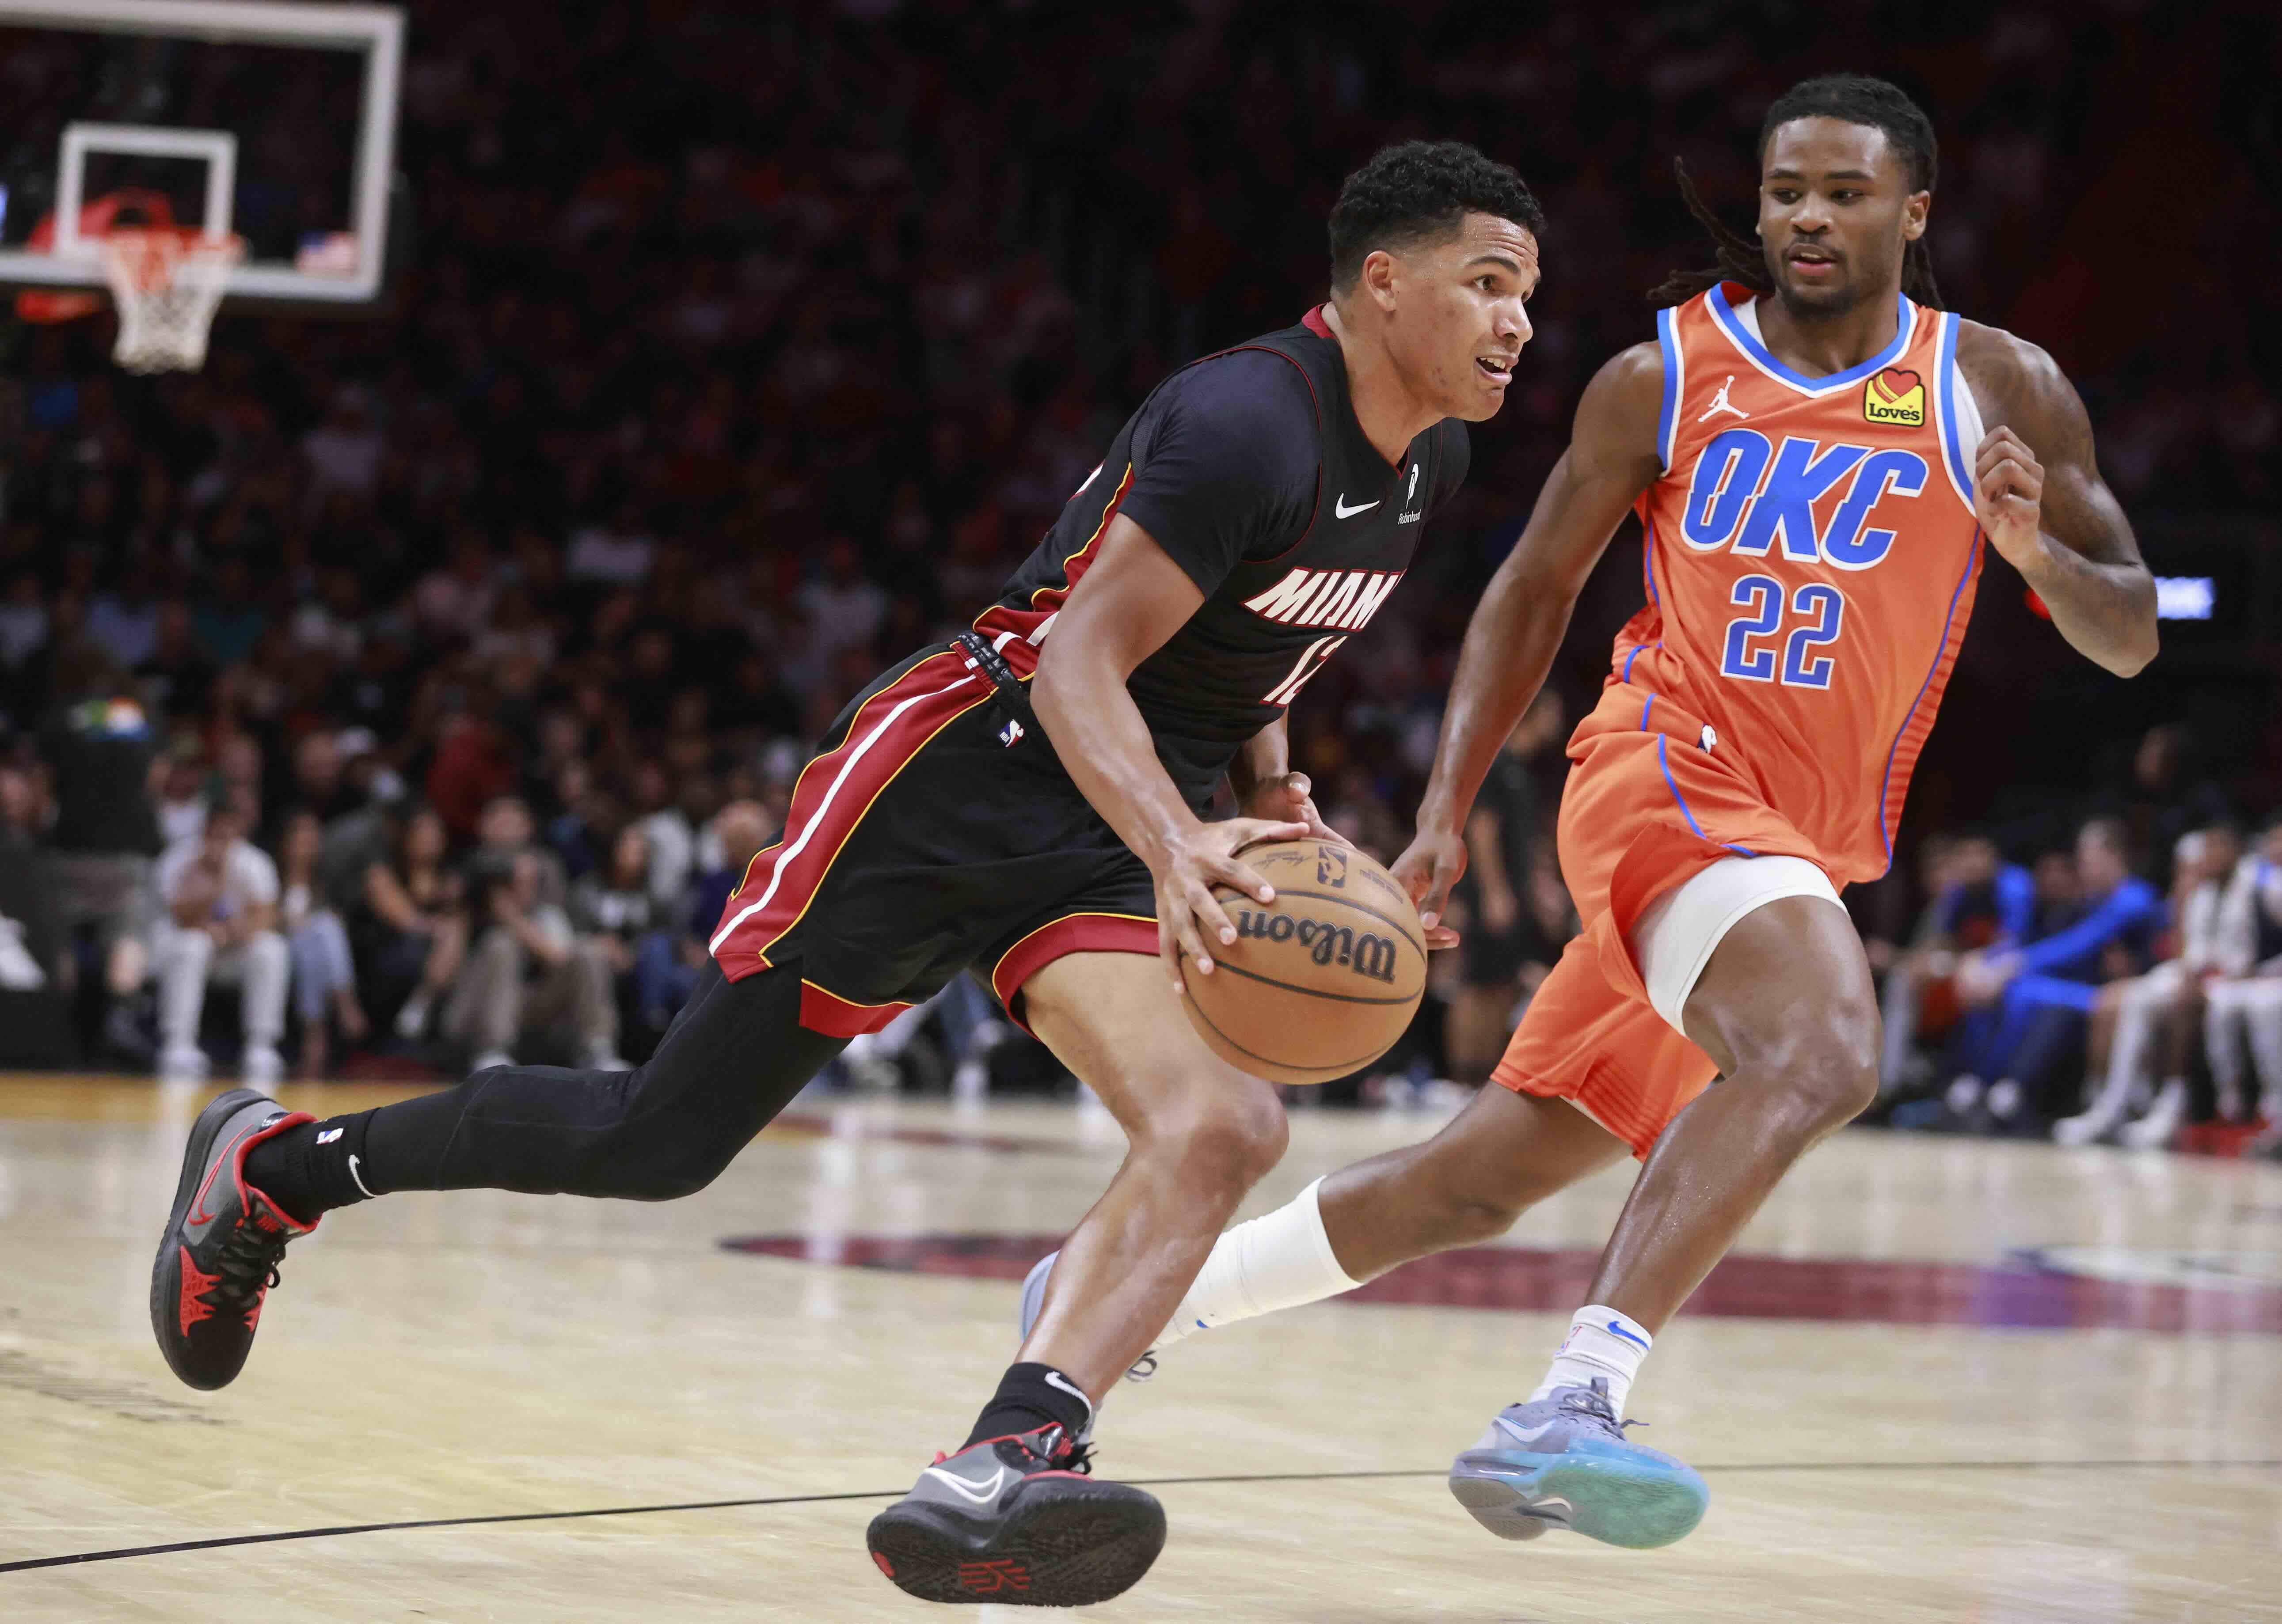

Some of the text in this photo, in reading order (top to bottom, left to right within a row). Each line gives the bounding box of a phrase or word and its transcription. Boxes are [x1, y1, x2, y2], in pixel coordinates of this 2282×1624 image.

[1680, 428, 1930, 571] OKC
[1240, 566, 1407, 633] MIAM
[1720, 573, 1845, 690] 22
[1237, 909, 1397, 984] Wilson
